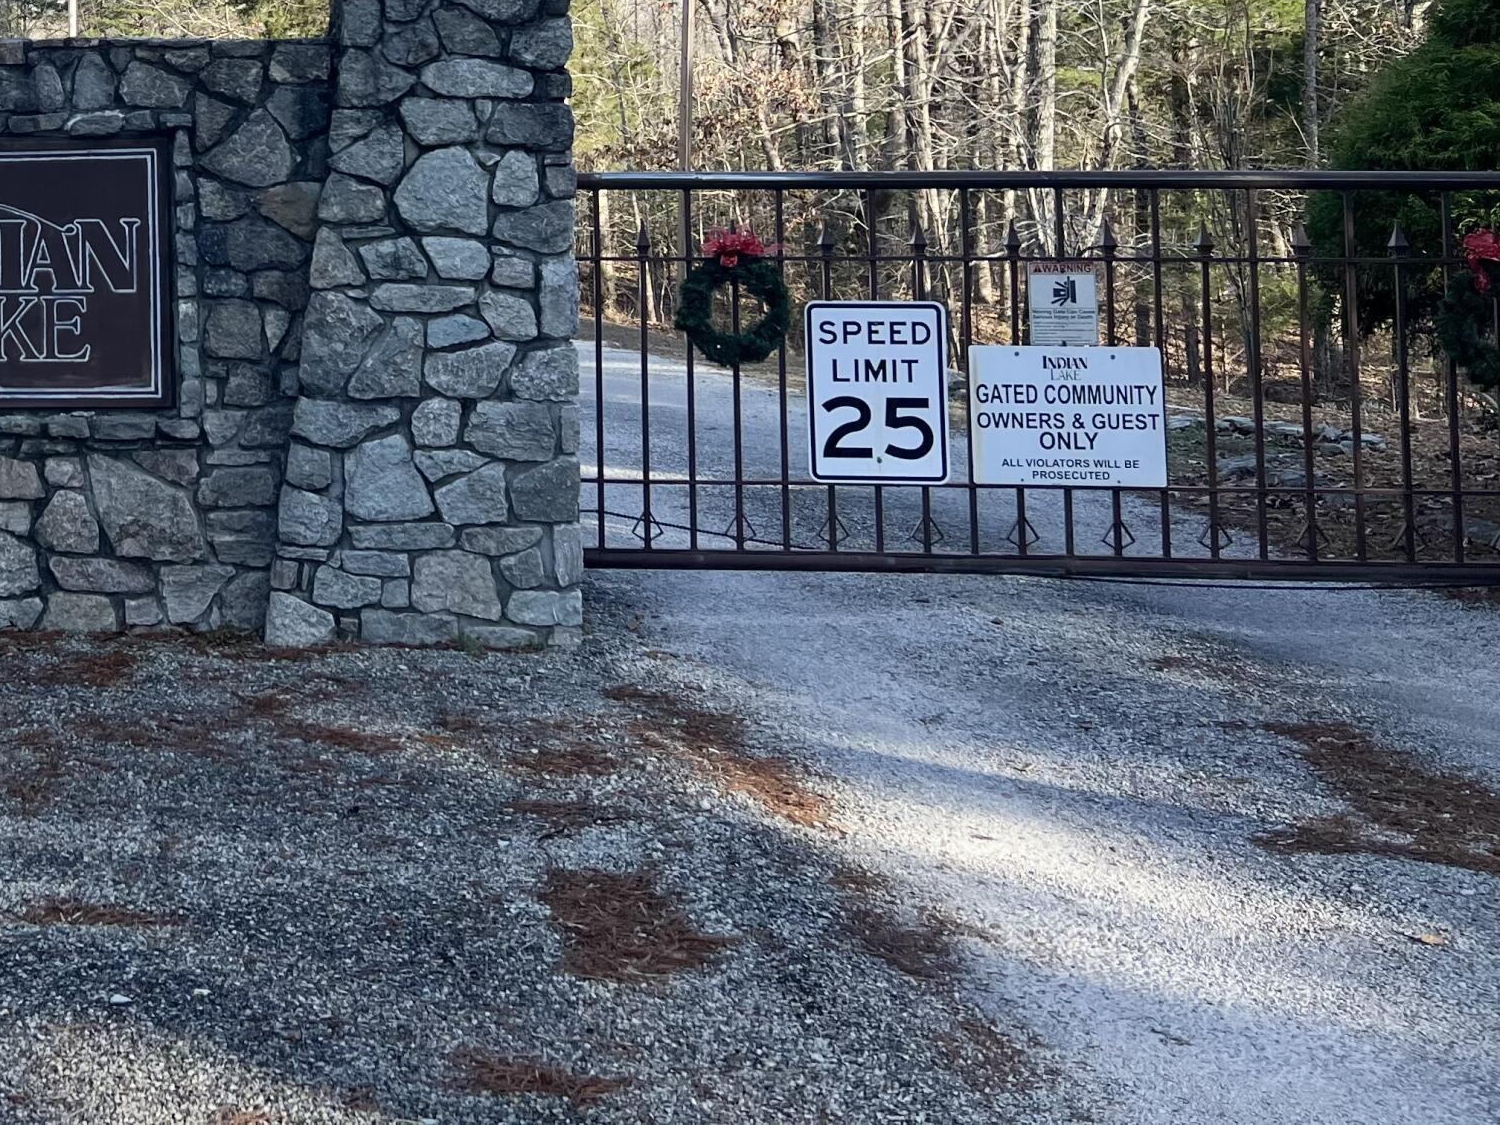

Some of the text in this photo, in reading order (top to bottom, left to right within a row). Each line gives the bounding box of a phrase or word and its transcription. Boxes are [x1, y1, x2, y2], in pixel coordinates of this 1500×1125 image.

[819, 321, 931, 345] SPEED
[832, 359, 919, 383] LIMIT
[1042, 355, 1088, 369] INDIAN
[1050, 368, 1082, 381] LAKE
[976, 384, 1157, 405] GATED COMMUNITY
[821, 395, 934, 460] 25
[977, 412, 1160, 430] OWNERS & GUEST
[1039, 432, 1099, 450] ONLY
[1002, 458, 1140, 468] ALL VIOLATORS WILL BE
[1032, 470, 1110, 480] PROSECUTED
